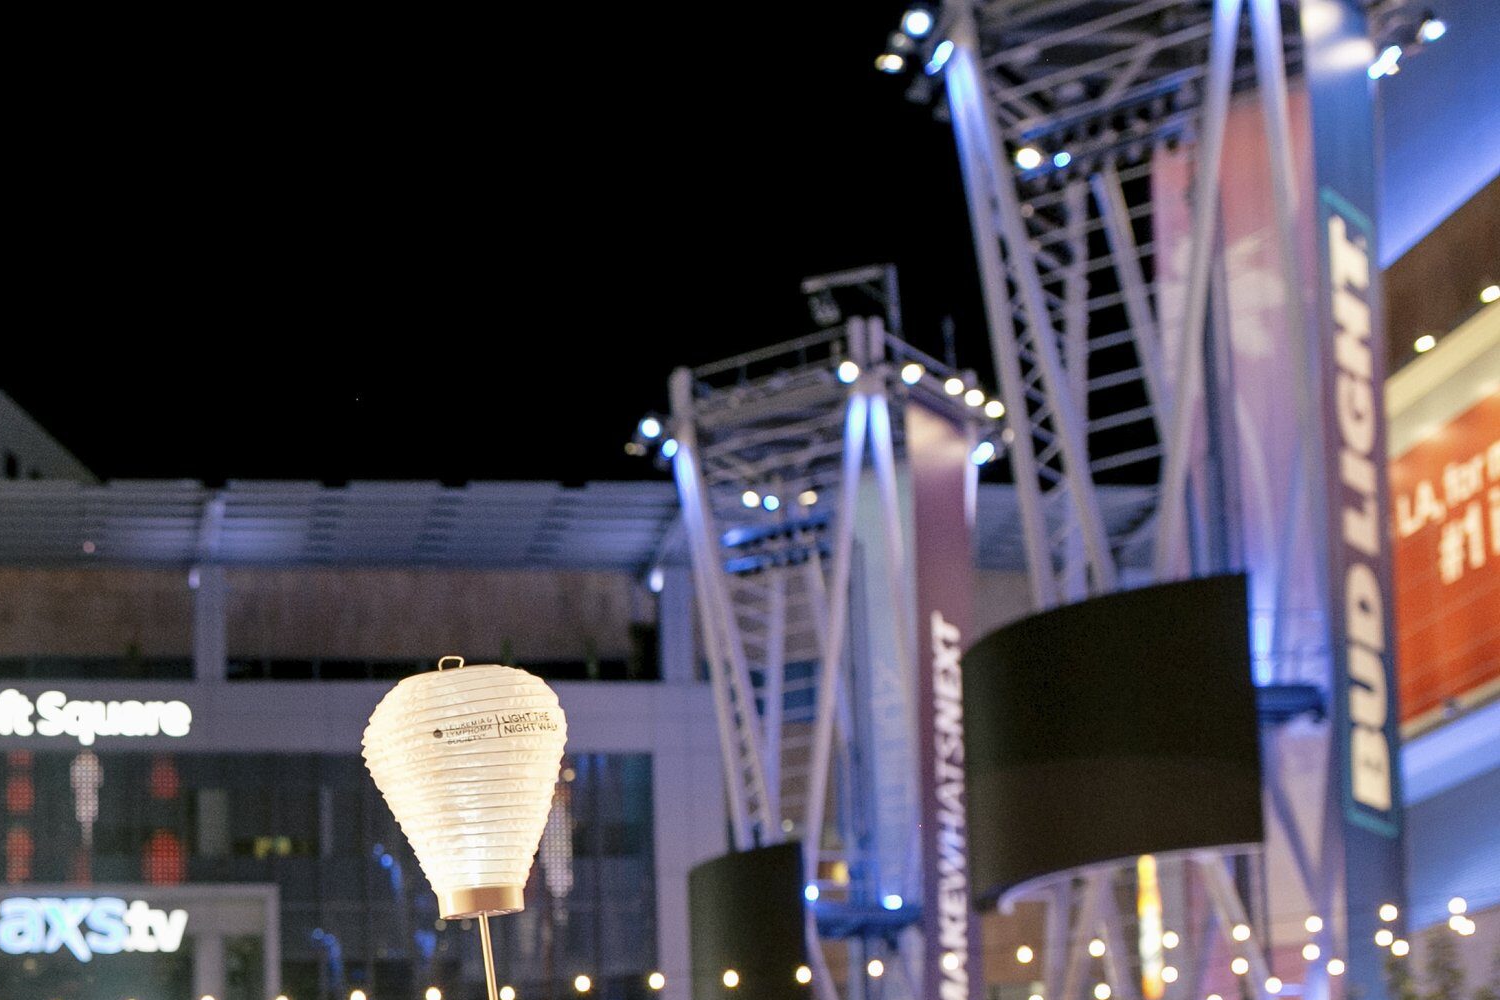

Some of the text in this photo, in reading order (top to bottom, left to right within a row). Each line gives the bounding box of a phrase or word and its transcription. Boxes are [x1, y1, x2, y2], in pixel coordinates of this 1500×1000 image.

[1328, 214, 1392, 812] BUD LIGHT
[36, 690, 192, 745] Square
[502, 712, 531, 724] LIGHT
[504, 723, 536, 734] NIGHT
